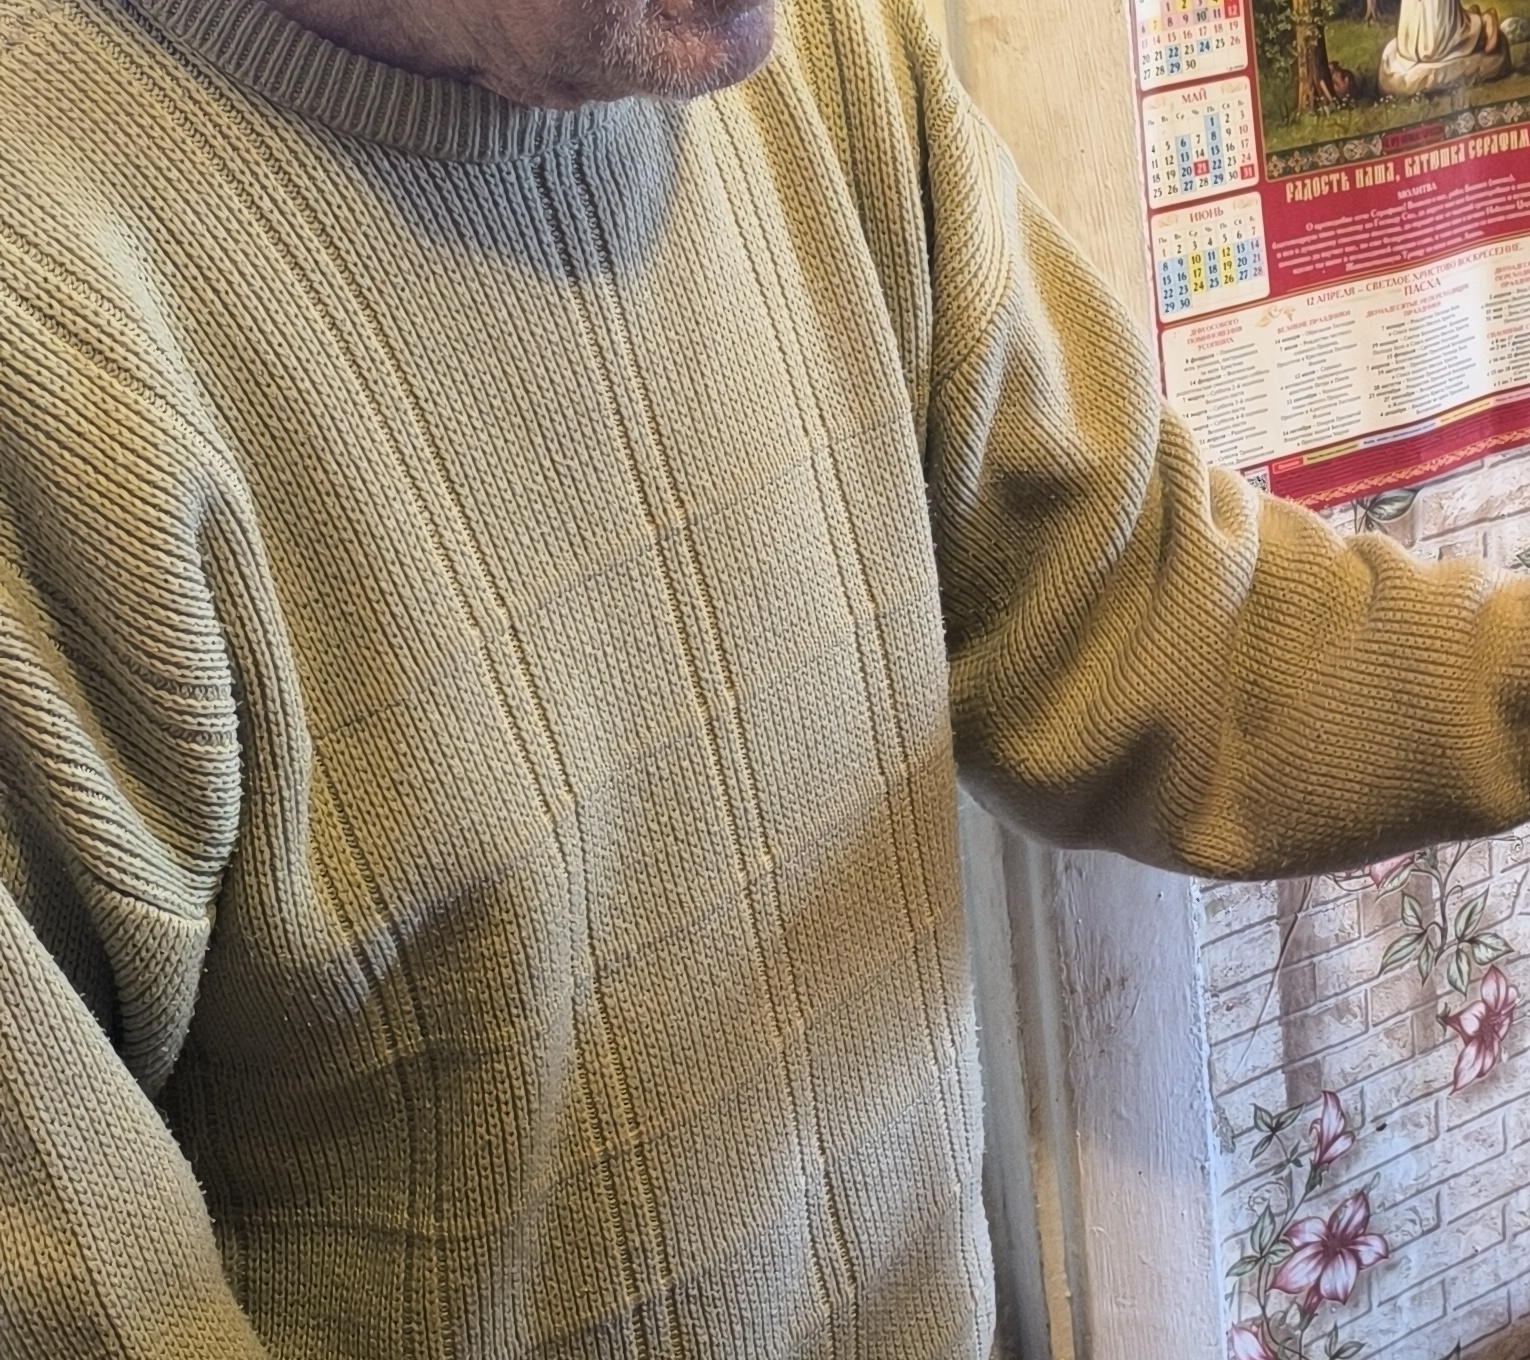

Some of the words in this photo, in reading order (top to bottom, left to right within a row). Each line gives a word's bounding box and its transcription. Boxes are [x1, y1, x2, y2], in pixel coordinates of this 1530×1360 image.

[1182, 88, 1207, 104] МАЙ
[1190, 207, 1223, 222] ИЮНЬ
[1306, 298, 1314, 306] 12
[1316, 287, 1355, 304] АПРЕЛЯ
[1365, 275, 1411, 292] СВЕТЛОЕ
[1412, 261, 1456, 280] ХРИСТОВО
[1404, 278, 1441, 296] ПАСХА
